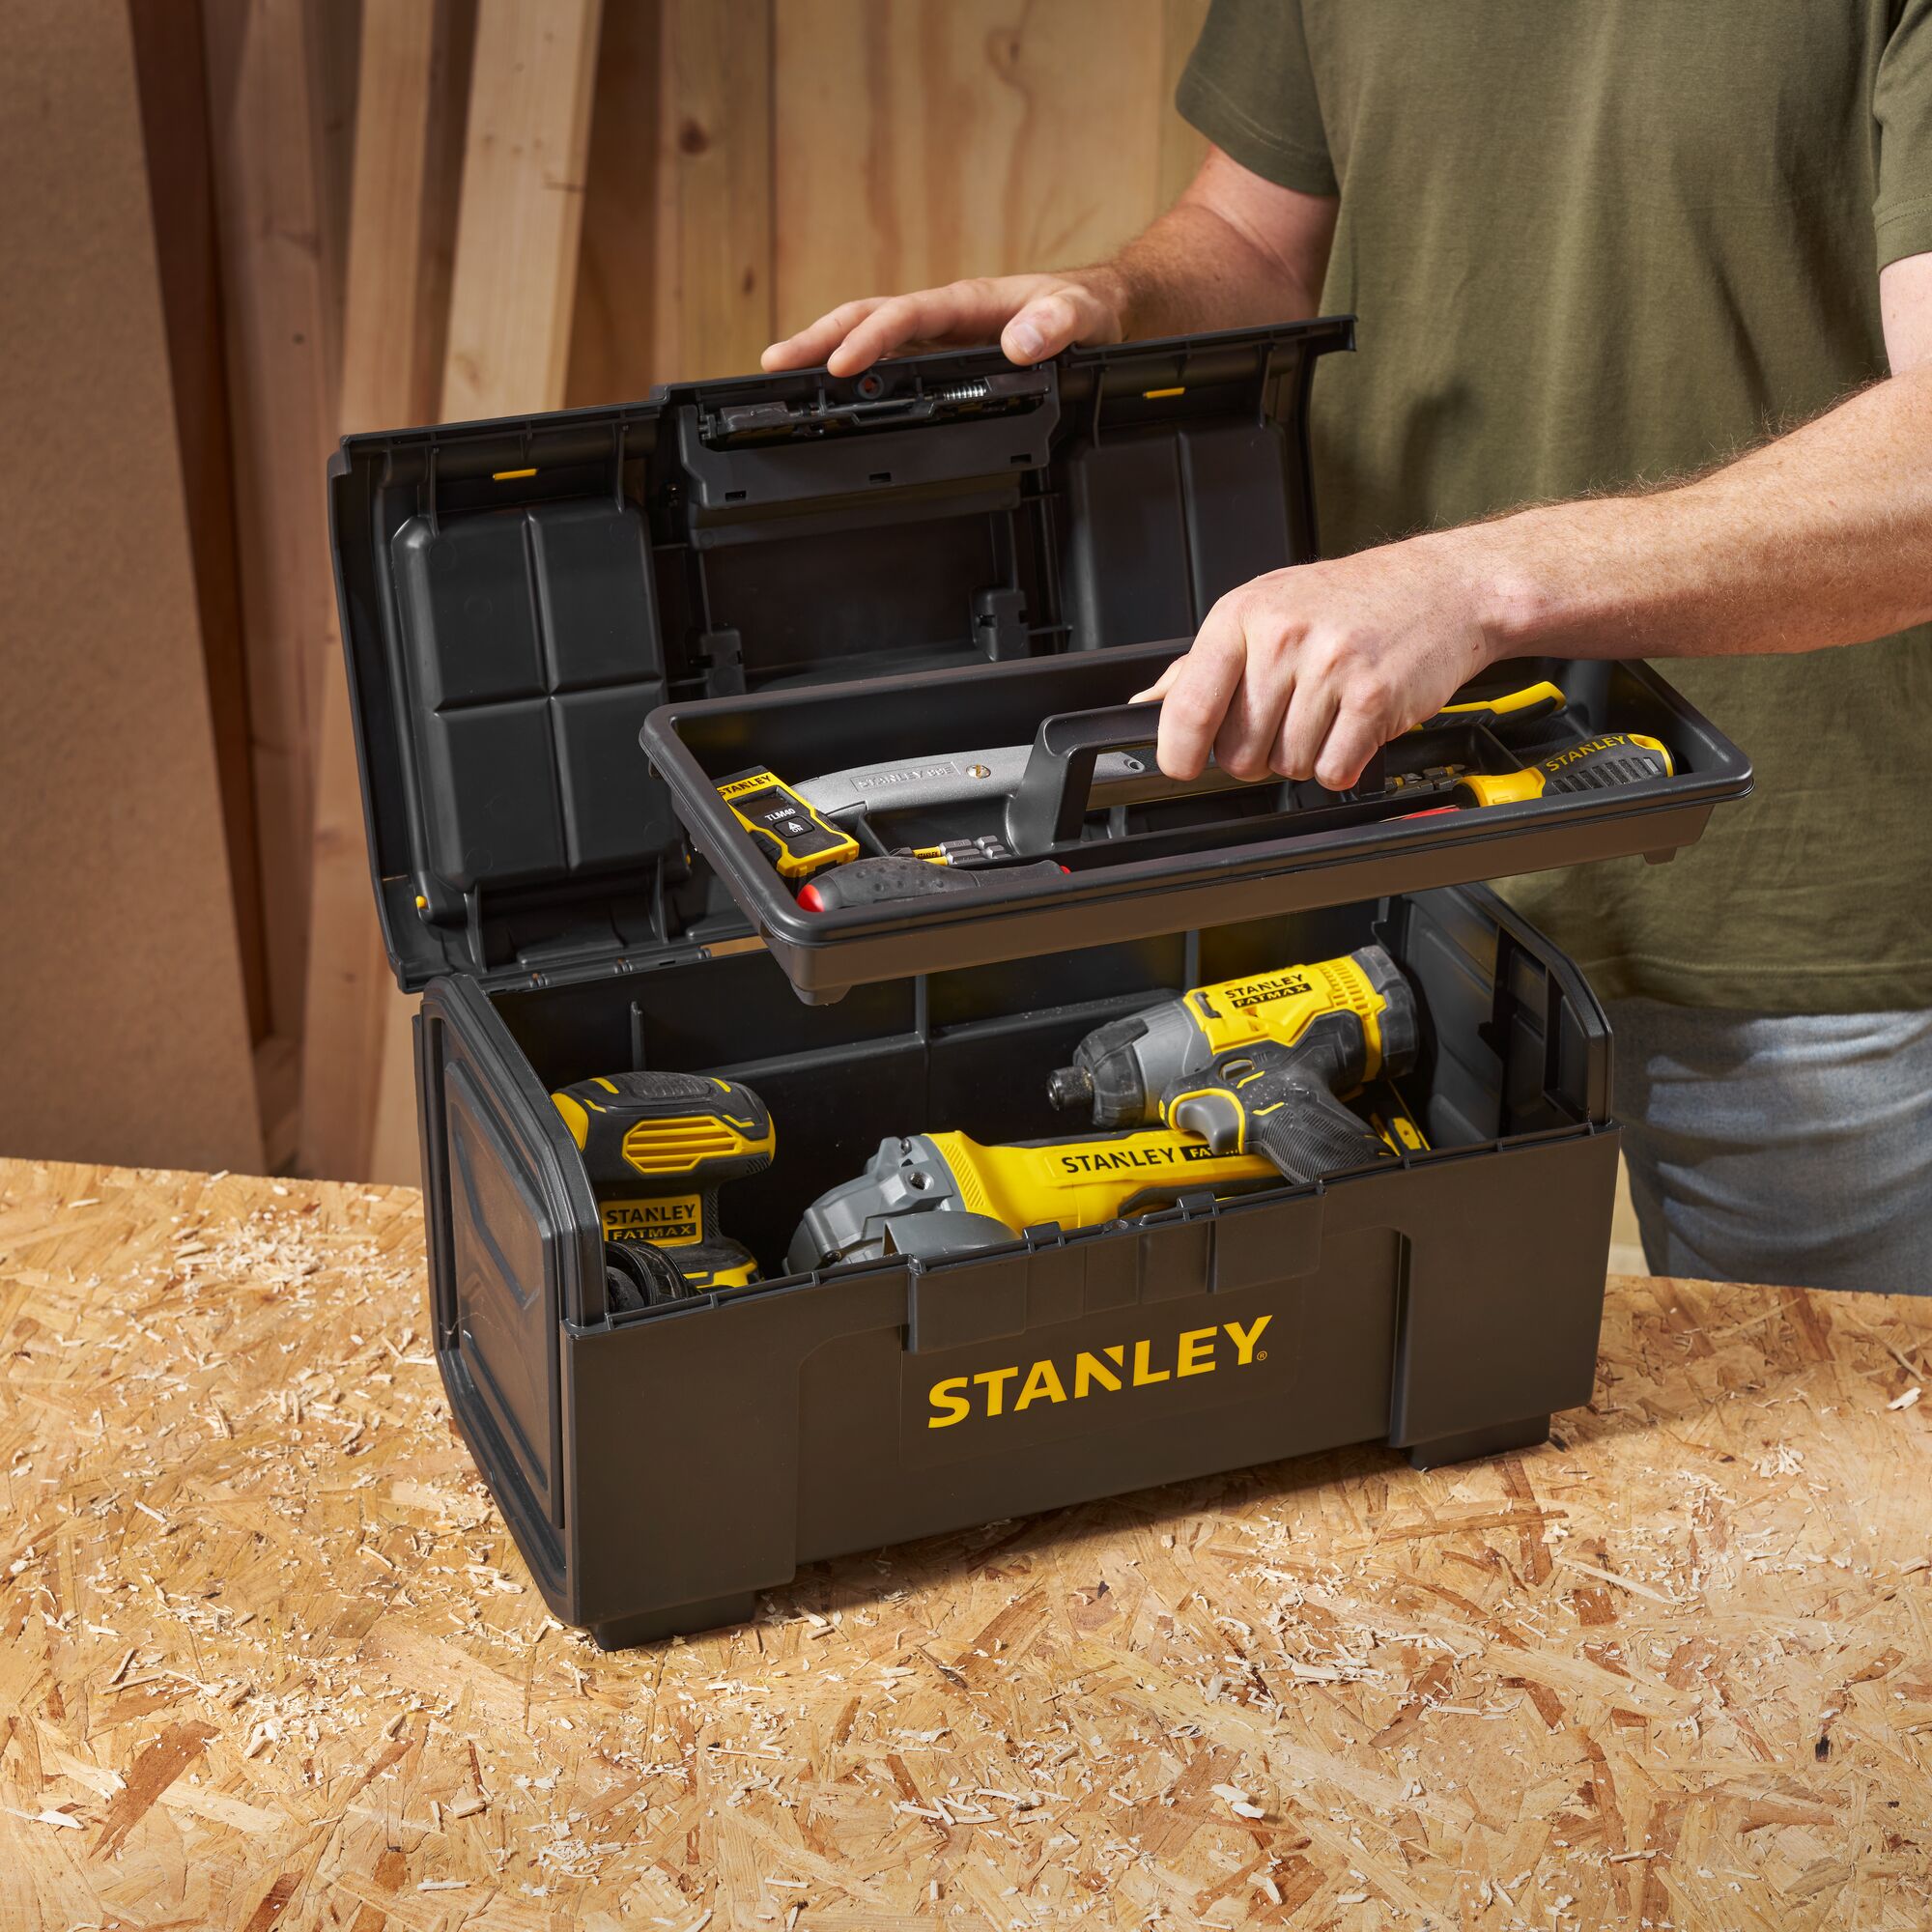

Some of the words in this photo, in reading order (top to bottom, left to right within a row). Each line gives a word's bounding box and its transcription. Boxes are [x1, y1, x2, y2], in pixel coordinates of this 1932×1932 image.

[1546, 735, 1627, 772] STANLEY
[718, 775, 772, 797] STANLEY
[858, 771, 923, 788] STANLEY
[764, 808, 796, 821] TLM40
[1225, 974, 1303, 999] STANLEY
[1236, 984, 1308, 1007] FATMAX
[1062, 1147, 1175, 1174] STANLEY
[607, 1204, 696, 1225] STANLEY
[612, 1225, 692, 1240] FATMAX
[927, 1314, 1273, 1429] STANLEY
